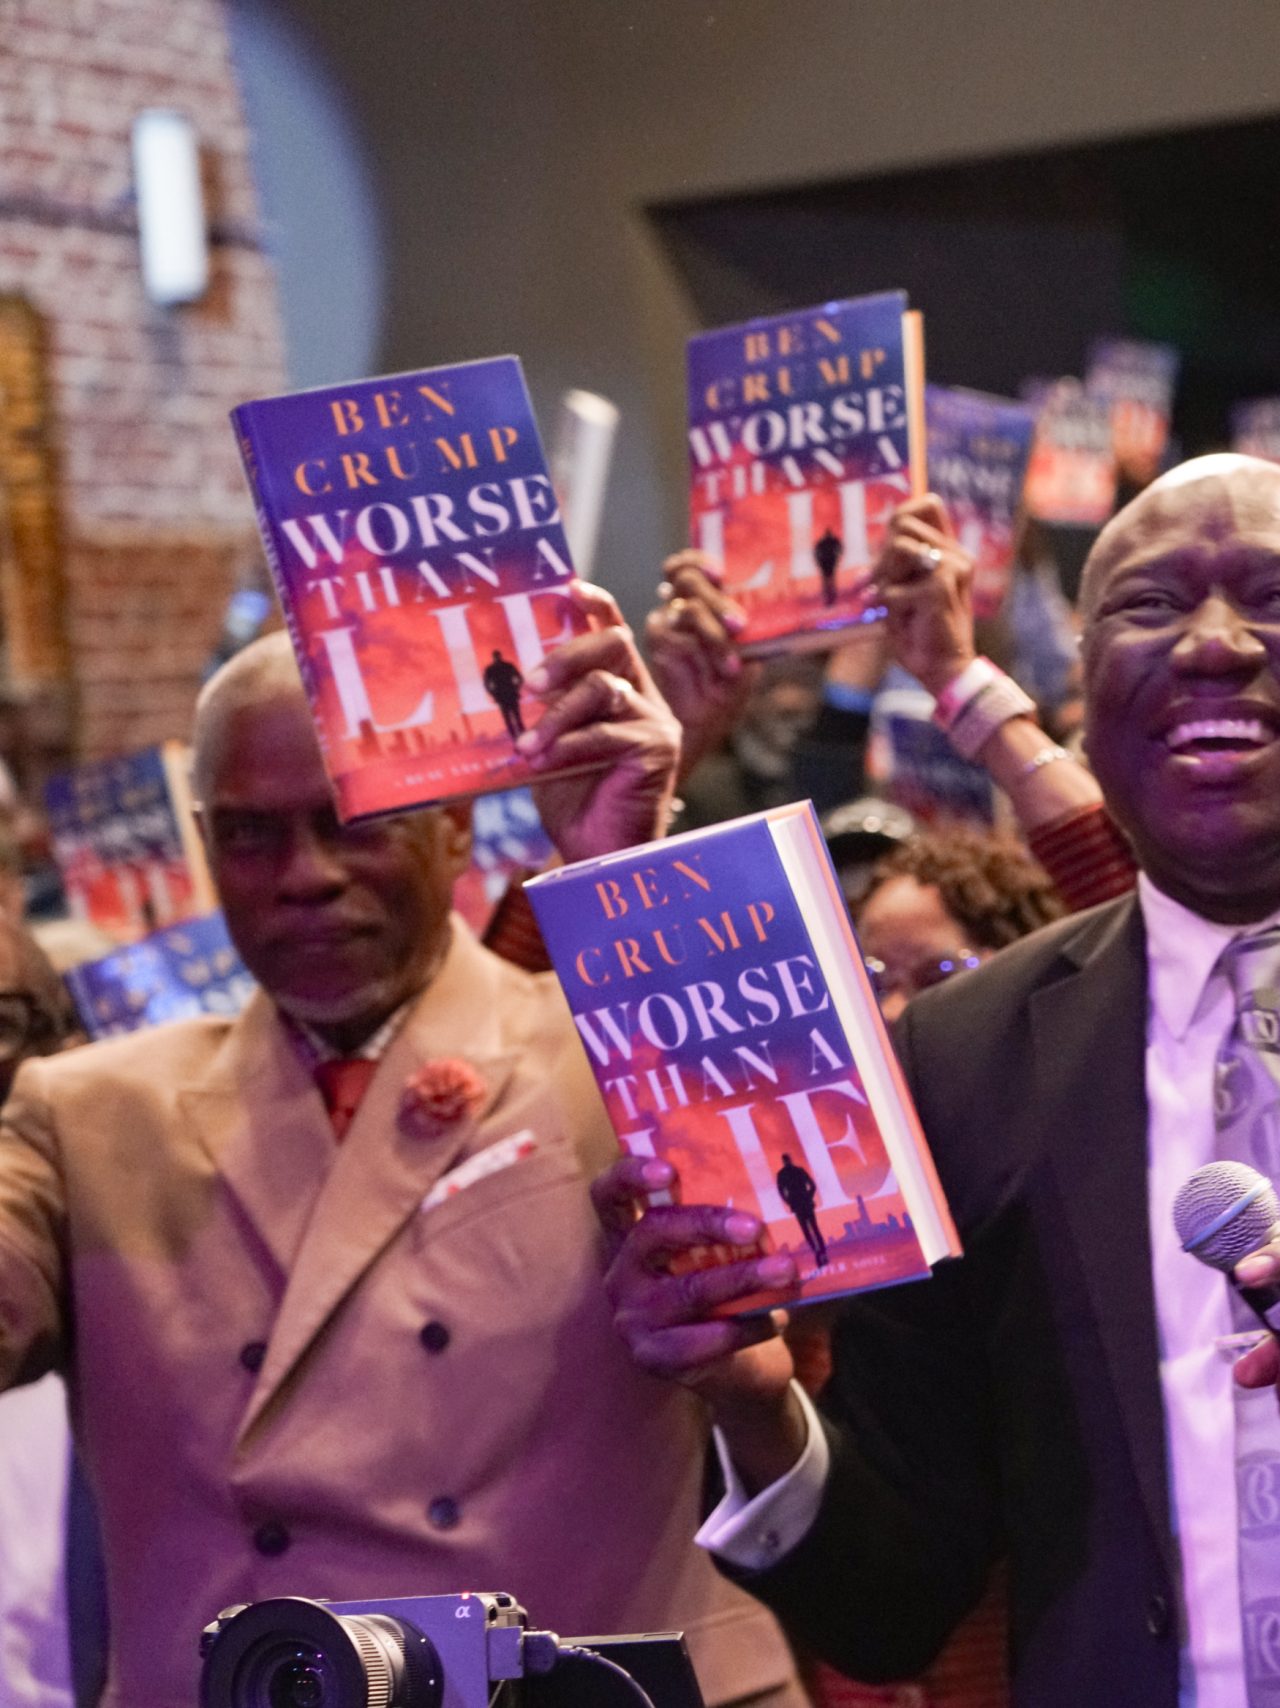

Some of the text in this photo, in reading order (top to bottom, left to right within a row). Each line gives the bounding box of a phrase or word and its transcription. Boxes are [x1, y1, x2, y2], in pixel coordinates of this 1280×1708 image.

[706, 348, 886, 409] CRUMP
[744, 319, 842, 363] BEN
[330, 382, 456, 435] BEN
[689, 383, 906, 467] WORSE
[294, 426, 518, 497] CRUMP
[695, 447, 845, 504] THAN
[281, 474, 562, 569] WORSE
[306, 547, 500, 619] THAN
[533, 537, 570, 580] A
[594, 854, 712, 920] BEN
[575, 900, 777, 988] CRUMP
[574, 954, 829, 1068] WORSE
[605, 1027, 846, 1121] THAN A
